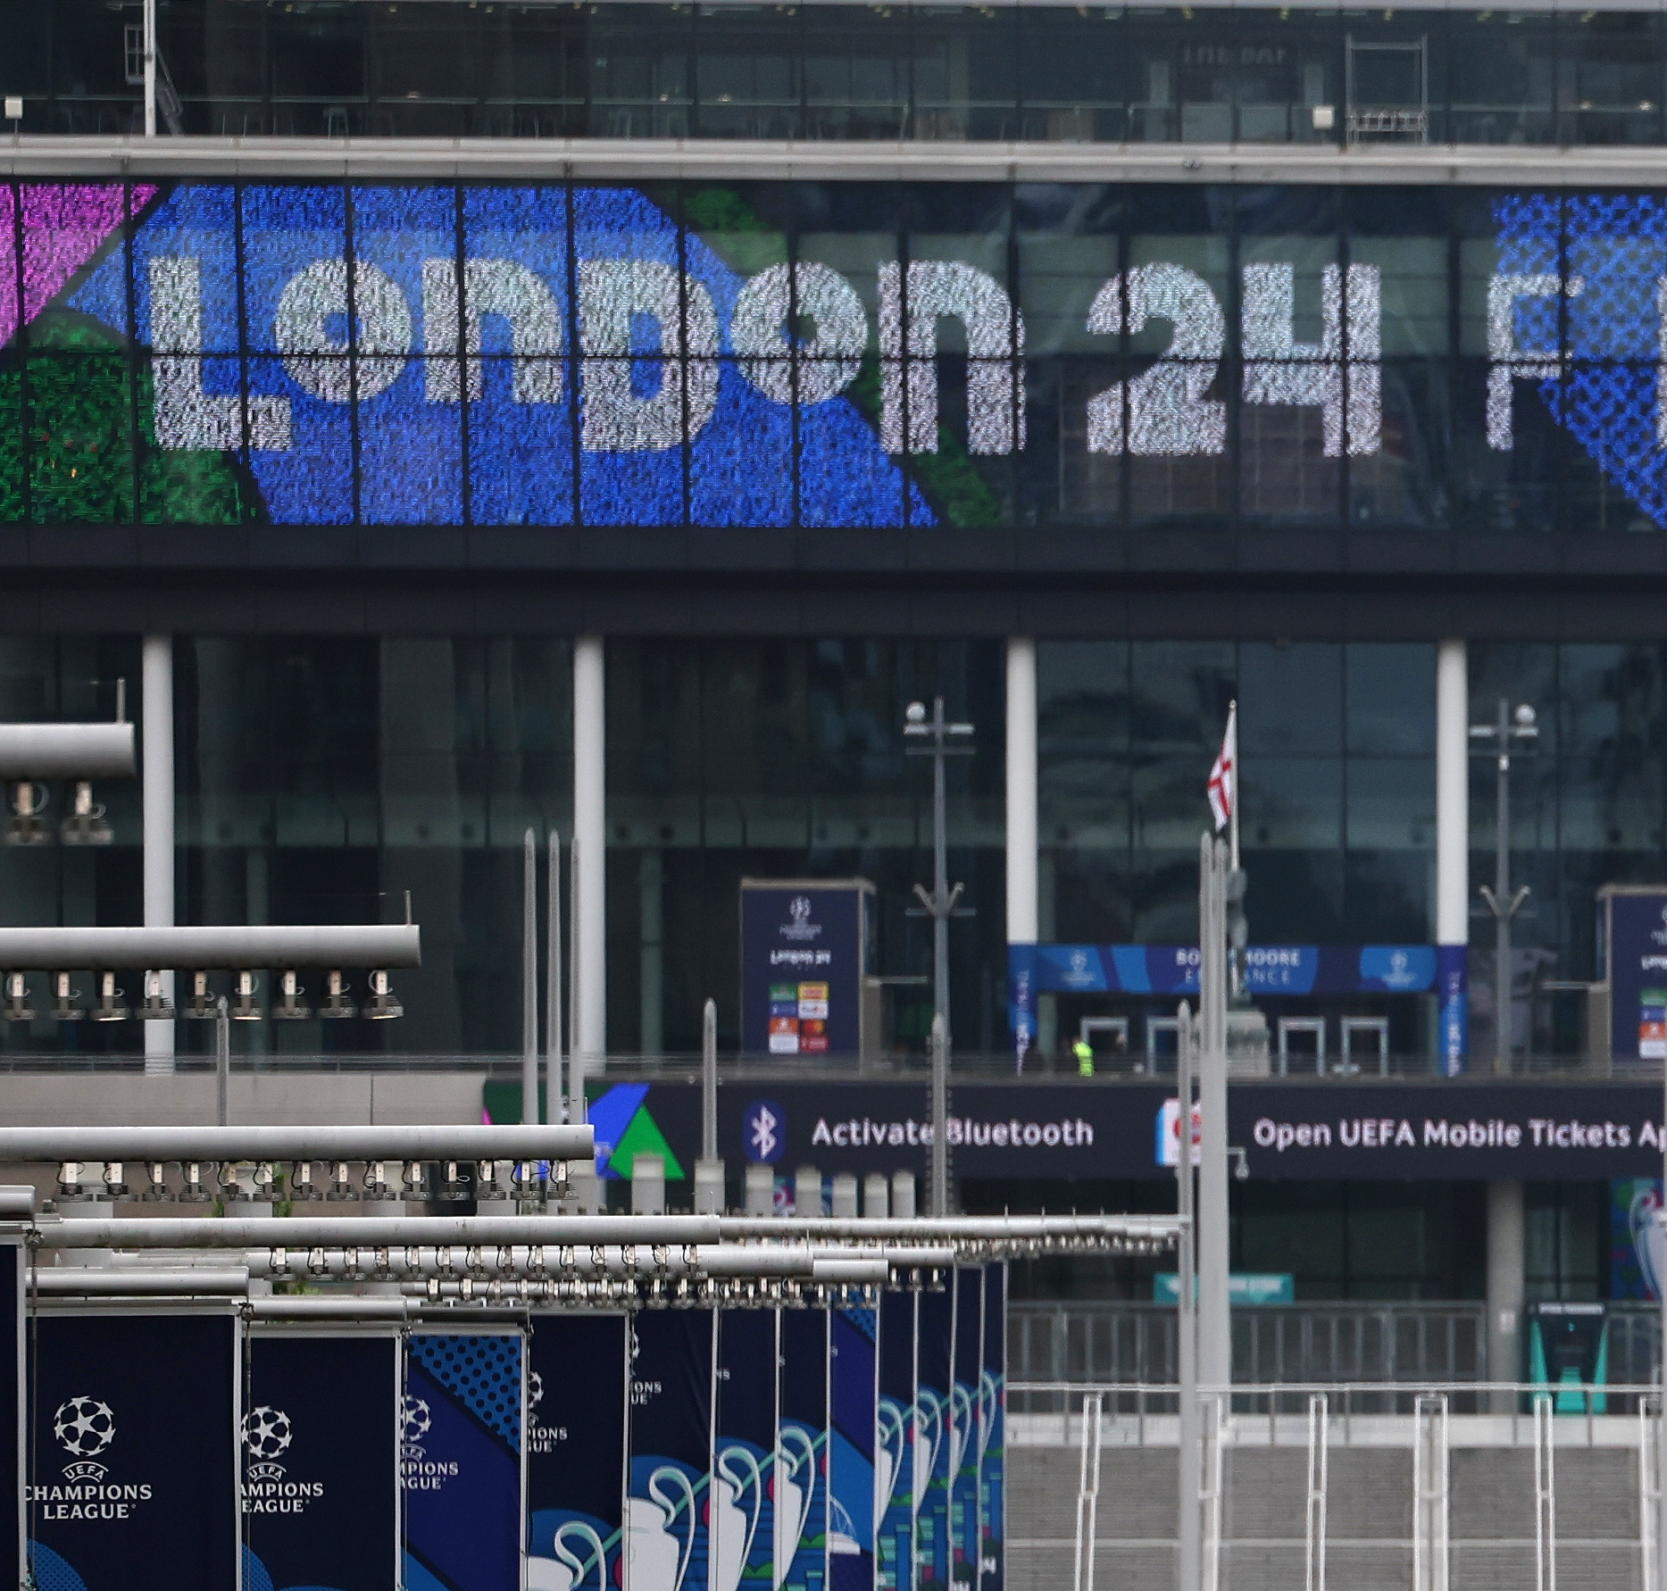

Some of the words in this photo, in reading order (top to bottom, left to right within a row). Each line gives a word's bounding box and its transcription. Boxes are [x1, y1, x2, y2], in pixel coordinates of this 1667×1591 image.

[1086, 260, 1382, 457] 24
[812, 1118, 932, 1146] Activate
[945, 1117, 1094, 1146] Bluetooth
[1254, 1120, 1331, 1152] Open
[1340, 1119, 1415, 1147] UEFA
[1424, 1118, 1520, 1147] Mobile
[1528, 1118, 1631, 1147] Tickets
[64, 1465, 105, 1480] UEFA
[249, 1466, 283, 1479] UEFA
[400, 1462, 459, 1475] PIONS
[240, 1482, 324, 1497] AMPIONS
[44, 1504, 129, 1520] LEAGUE
[241, 1499, 304, 1513] EAGUE
